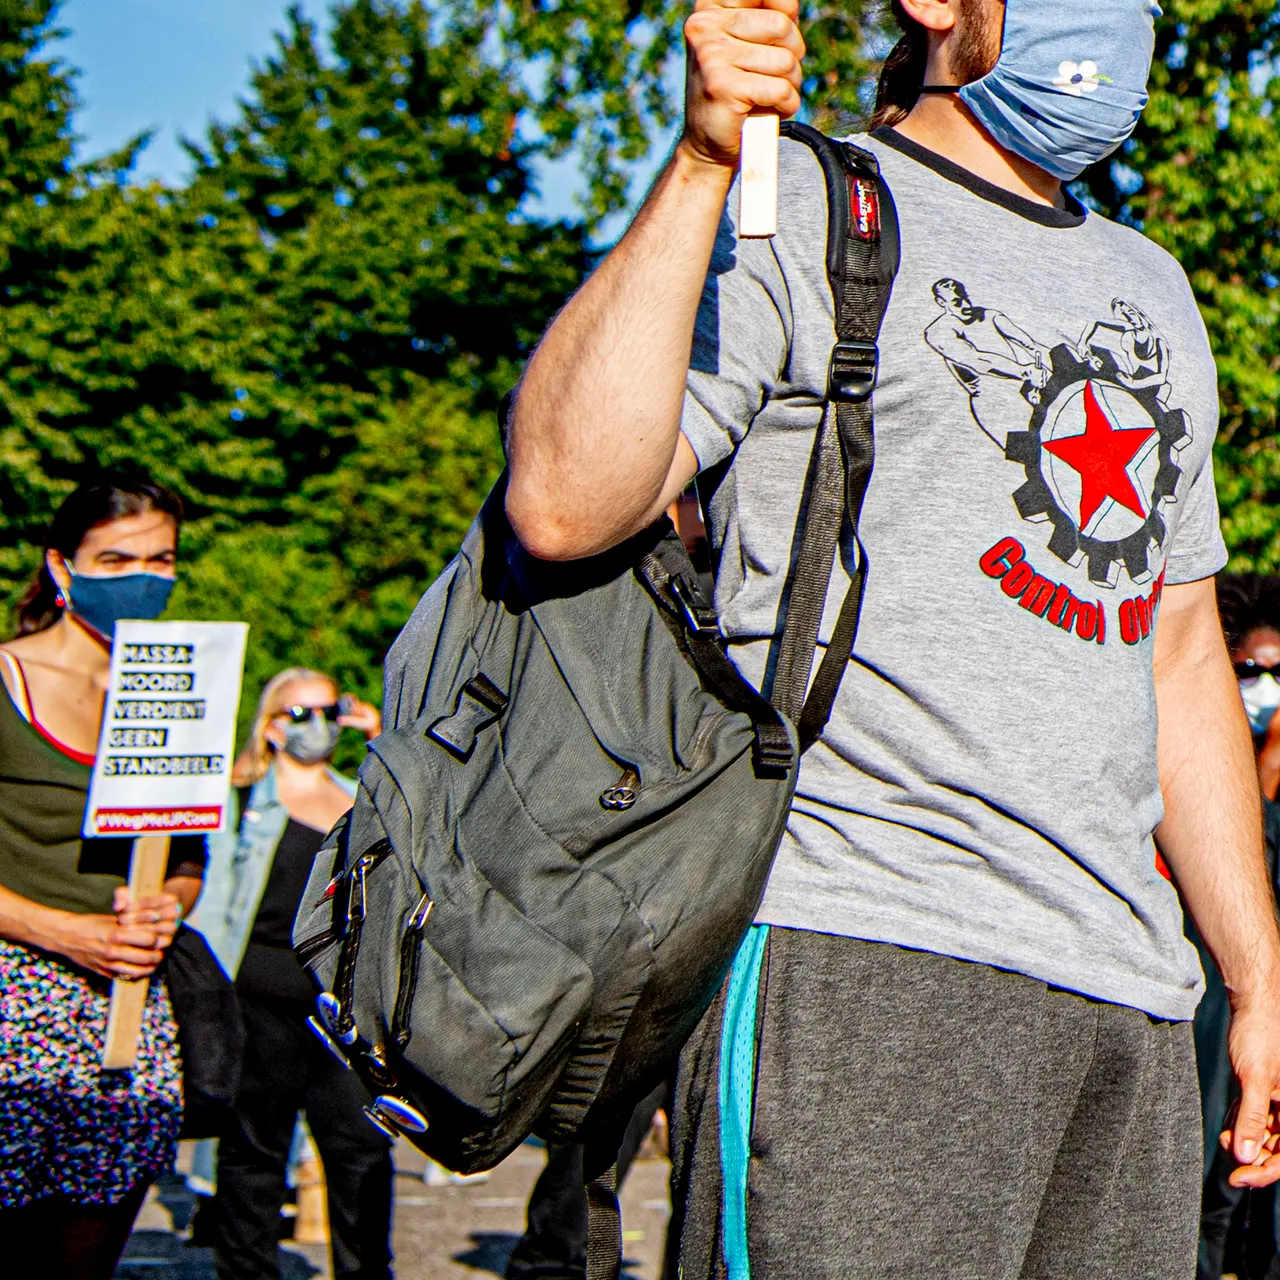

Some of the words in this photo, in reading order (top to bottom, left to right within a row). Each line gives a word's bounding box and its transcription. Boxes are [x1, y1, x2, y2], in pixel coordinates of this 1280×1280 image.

[979, 536, 1107, 645] Control
[119, 673, 190, 691] MOORD
[114, 701, 206, 719] VERDIENT
[109, 729, 165, 747] GEEN
[104, 757, 224, 775] STANDBEELD
